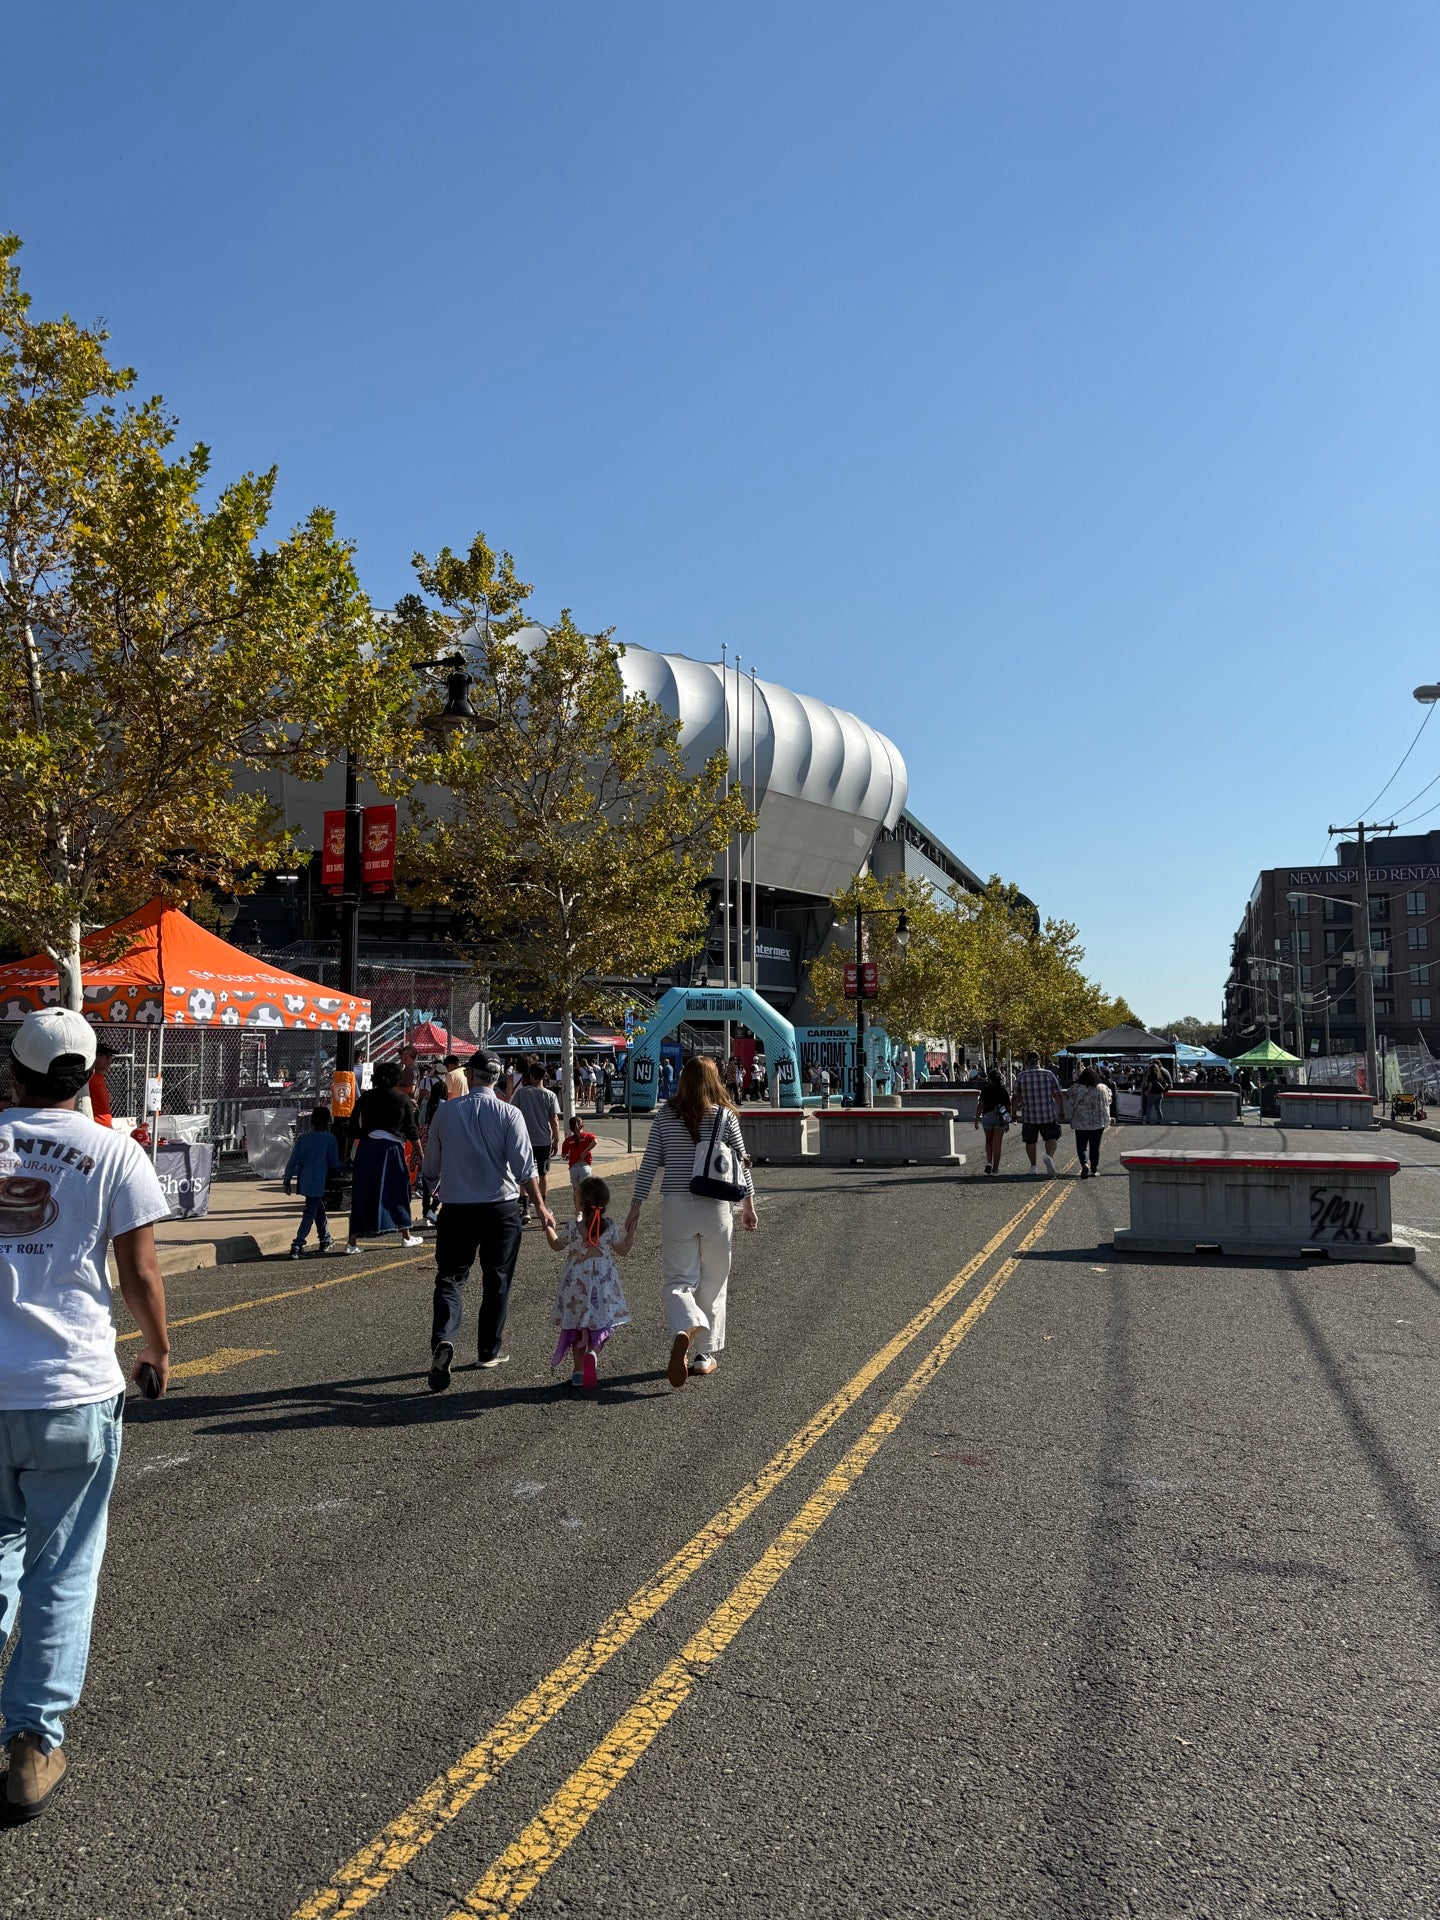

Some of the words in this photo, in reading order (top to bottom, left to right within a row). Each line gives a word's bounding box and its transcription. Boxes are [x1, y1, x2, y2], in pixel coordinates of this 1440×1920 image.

[1289, 871, 1322, 885] NEW
[1326, 869, 1387, 884] INSPIED
[755, 943, 791, 957] ntermex
[518, 1036, 533, 1045] THE
[800, 1041, 847, 1067] WELCOME
[157, 1173, 202, 1195] Shots
